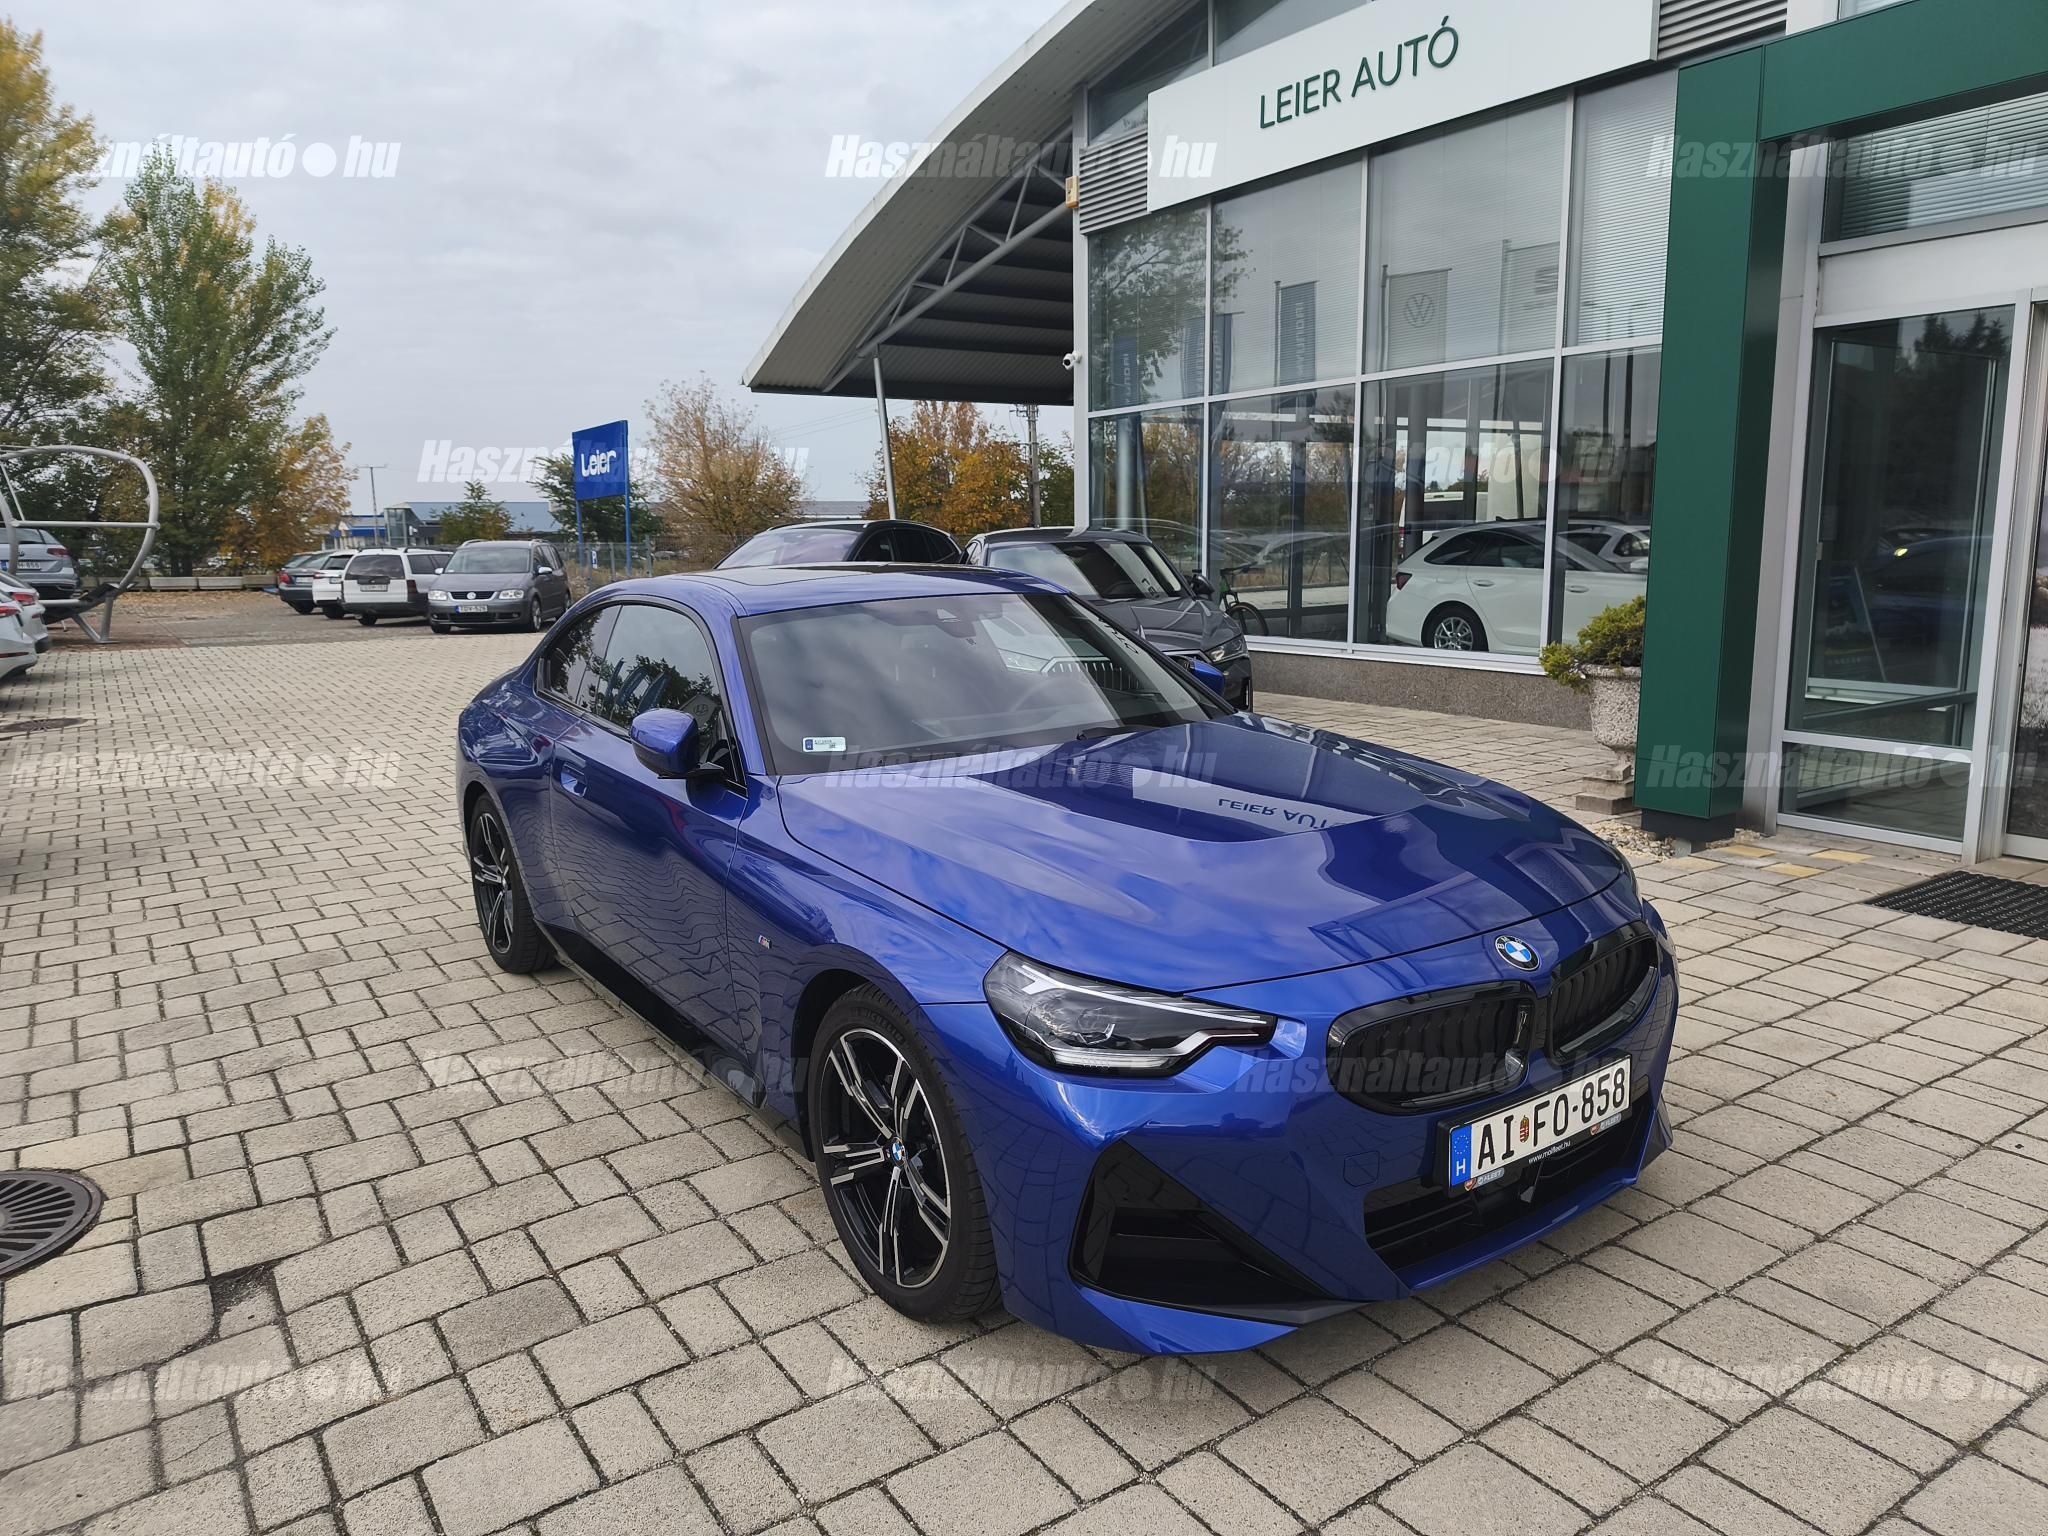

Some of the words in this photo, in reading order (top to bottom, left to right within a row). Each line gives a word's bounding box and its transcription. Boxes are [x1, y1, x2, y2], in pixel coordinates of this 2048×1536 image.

[1260, 69, 1341, 129] LEIER
[1351, 15, 1459, 98] AUTÓ
[581, 449, 617, 478] Leier
[1456, 1158, 1466, 1177] H
[1477, 1115, 1515, 1170] AI
[1533, 1067, 1626, 1147] FO-858
